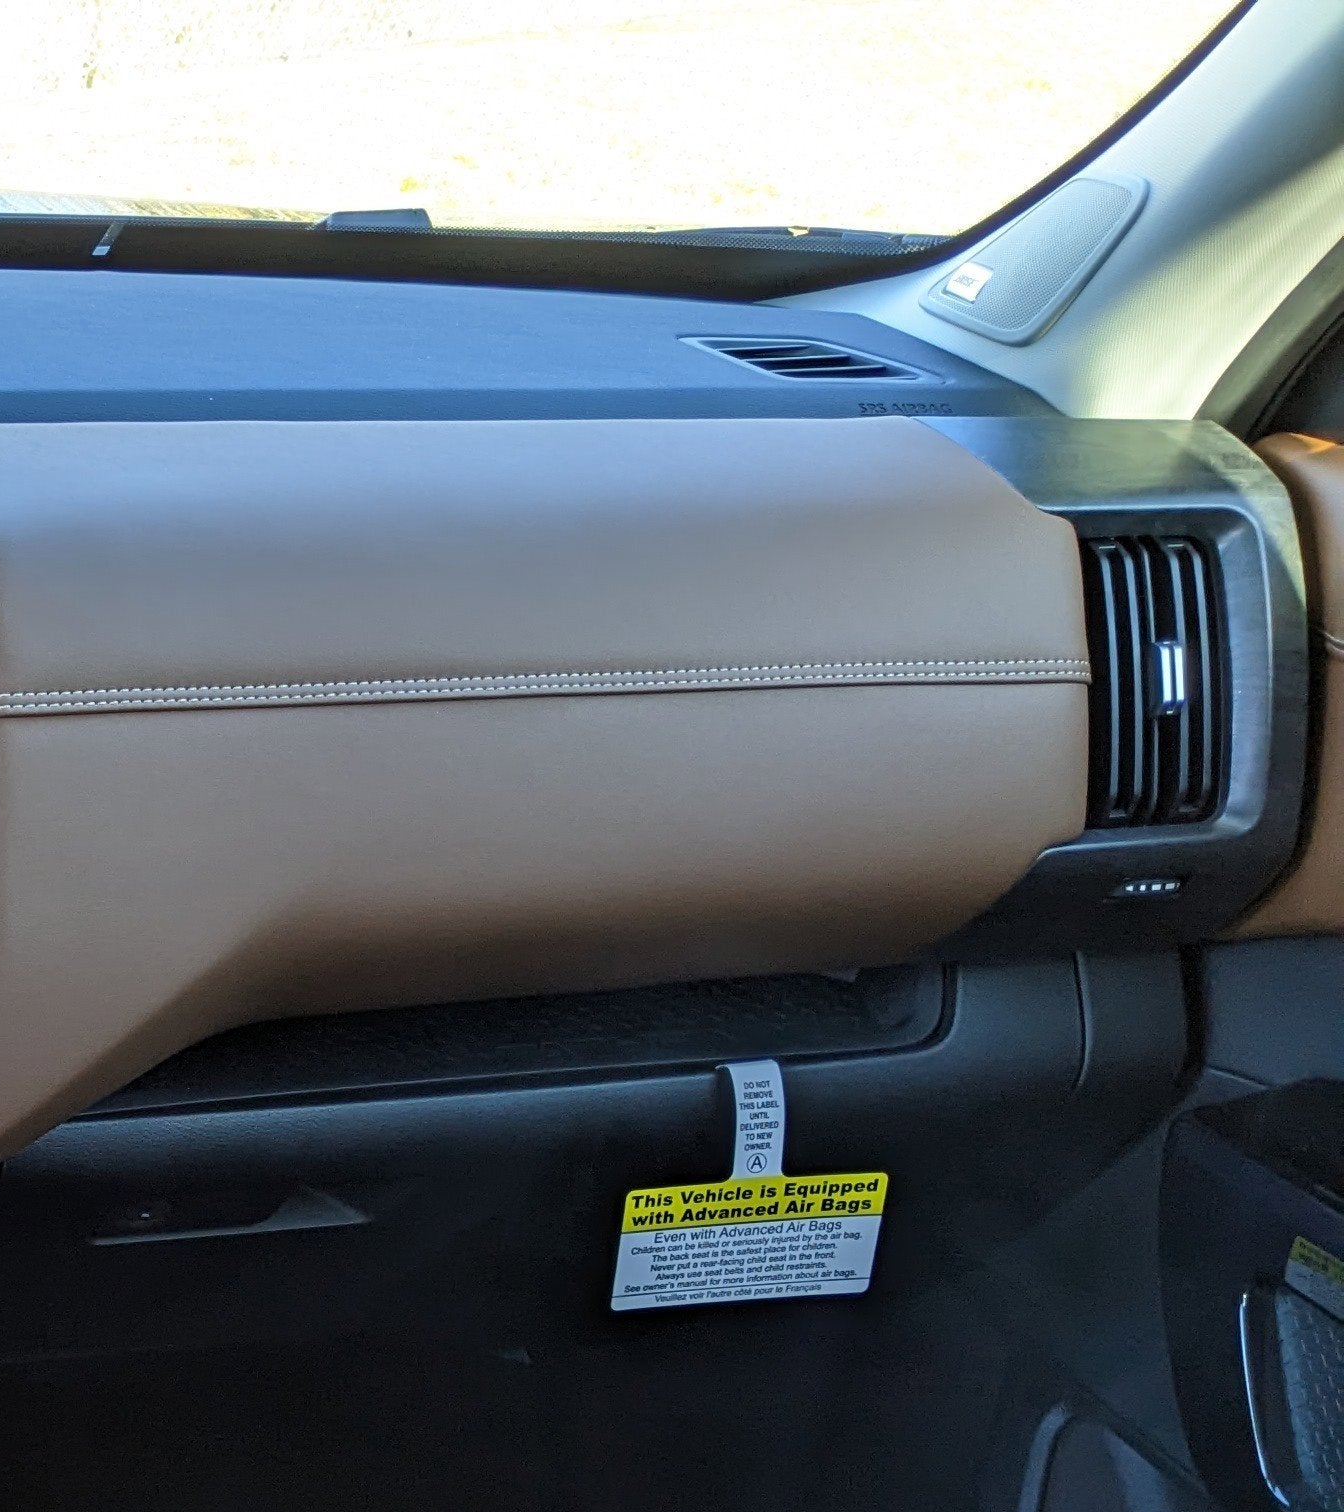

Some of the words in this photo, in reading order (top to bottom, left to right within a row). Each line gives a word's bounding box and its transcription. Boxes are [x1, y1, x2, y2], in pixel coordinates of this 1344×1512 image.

[744, 1091, 773, 1099] REMOVE
[740, 1121, 779, 1130] DELIVERED
[757, 1132, 772, 1140] NEW
[632, 1194, 673, 1209] This
[681, 1187, 753, 1204] Vehicle
[760, 1185, 776, 1198] is
[784, 1179, 879, 1198] Equipped
[632, 1211, 674, 1226] with
[680, 1202, 779, 1222] Advanced
[785, 1200, 815, 1213] Air
[821, 1199, 871, 1213] Bags
[654, 1232, 686, 1243] Even
[691, 1229, 715, 1240] with
[719, 1222, 783, 1238] Advanced
[786, 1222, 804, 1233] Air
[809, 1221, 842, 1232] Bags
[631, 1246, 665, 1255] Children
[685, 1242, 695, 1250] be
[698, 1241, 719, 1249] killed
[732, 1237, 769, 1246] seriously
[772, 1235, 800, 1244] injured
[802, 1234, 812, 1242] by
[692, 1251, 709, 1259] seat
[737, 1246, 761, 1255] safest
[764, 1245, 786, 1254] place
[789, 1243, 799, 1251] for
[802, 1242, 837, 1250] children.
[651, 1264, 675, 1272] Never
[677, 1262, 690, 1270] put
[700, 1258, 745, 1267] rear-facing
[747, 1256, 766, 1264] child
[624, 1285, 640, 1293] See
[677, 1280, 707, 1288] manual
[747, 1273, 792, 1283] information
[795, 1270, 818, 1279] about
[655, 1272, 684, 1281] Always
[725, 1267, 744, 1275] belts
[747, 1265, 762, 1274] and
